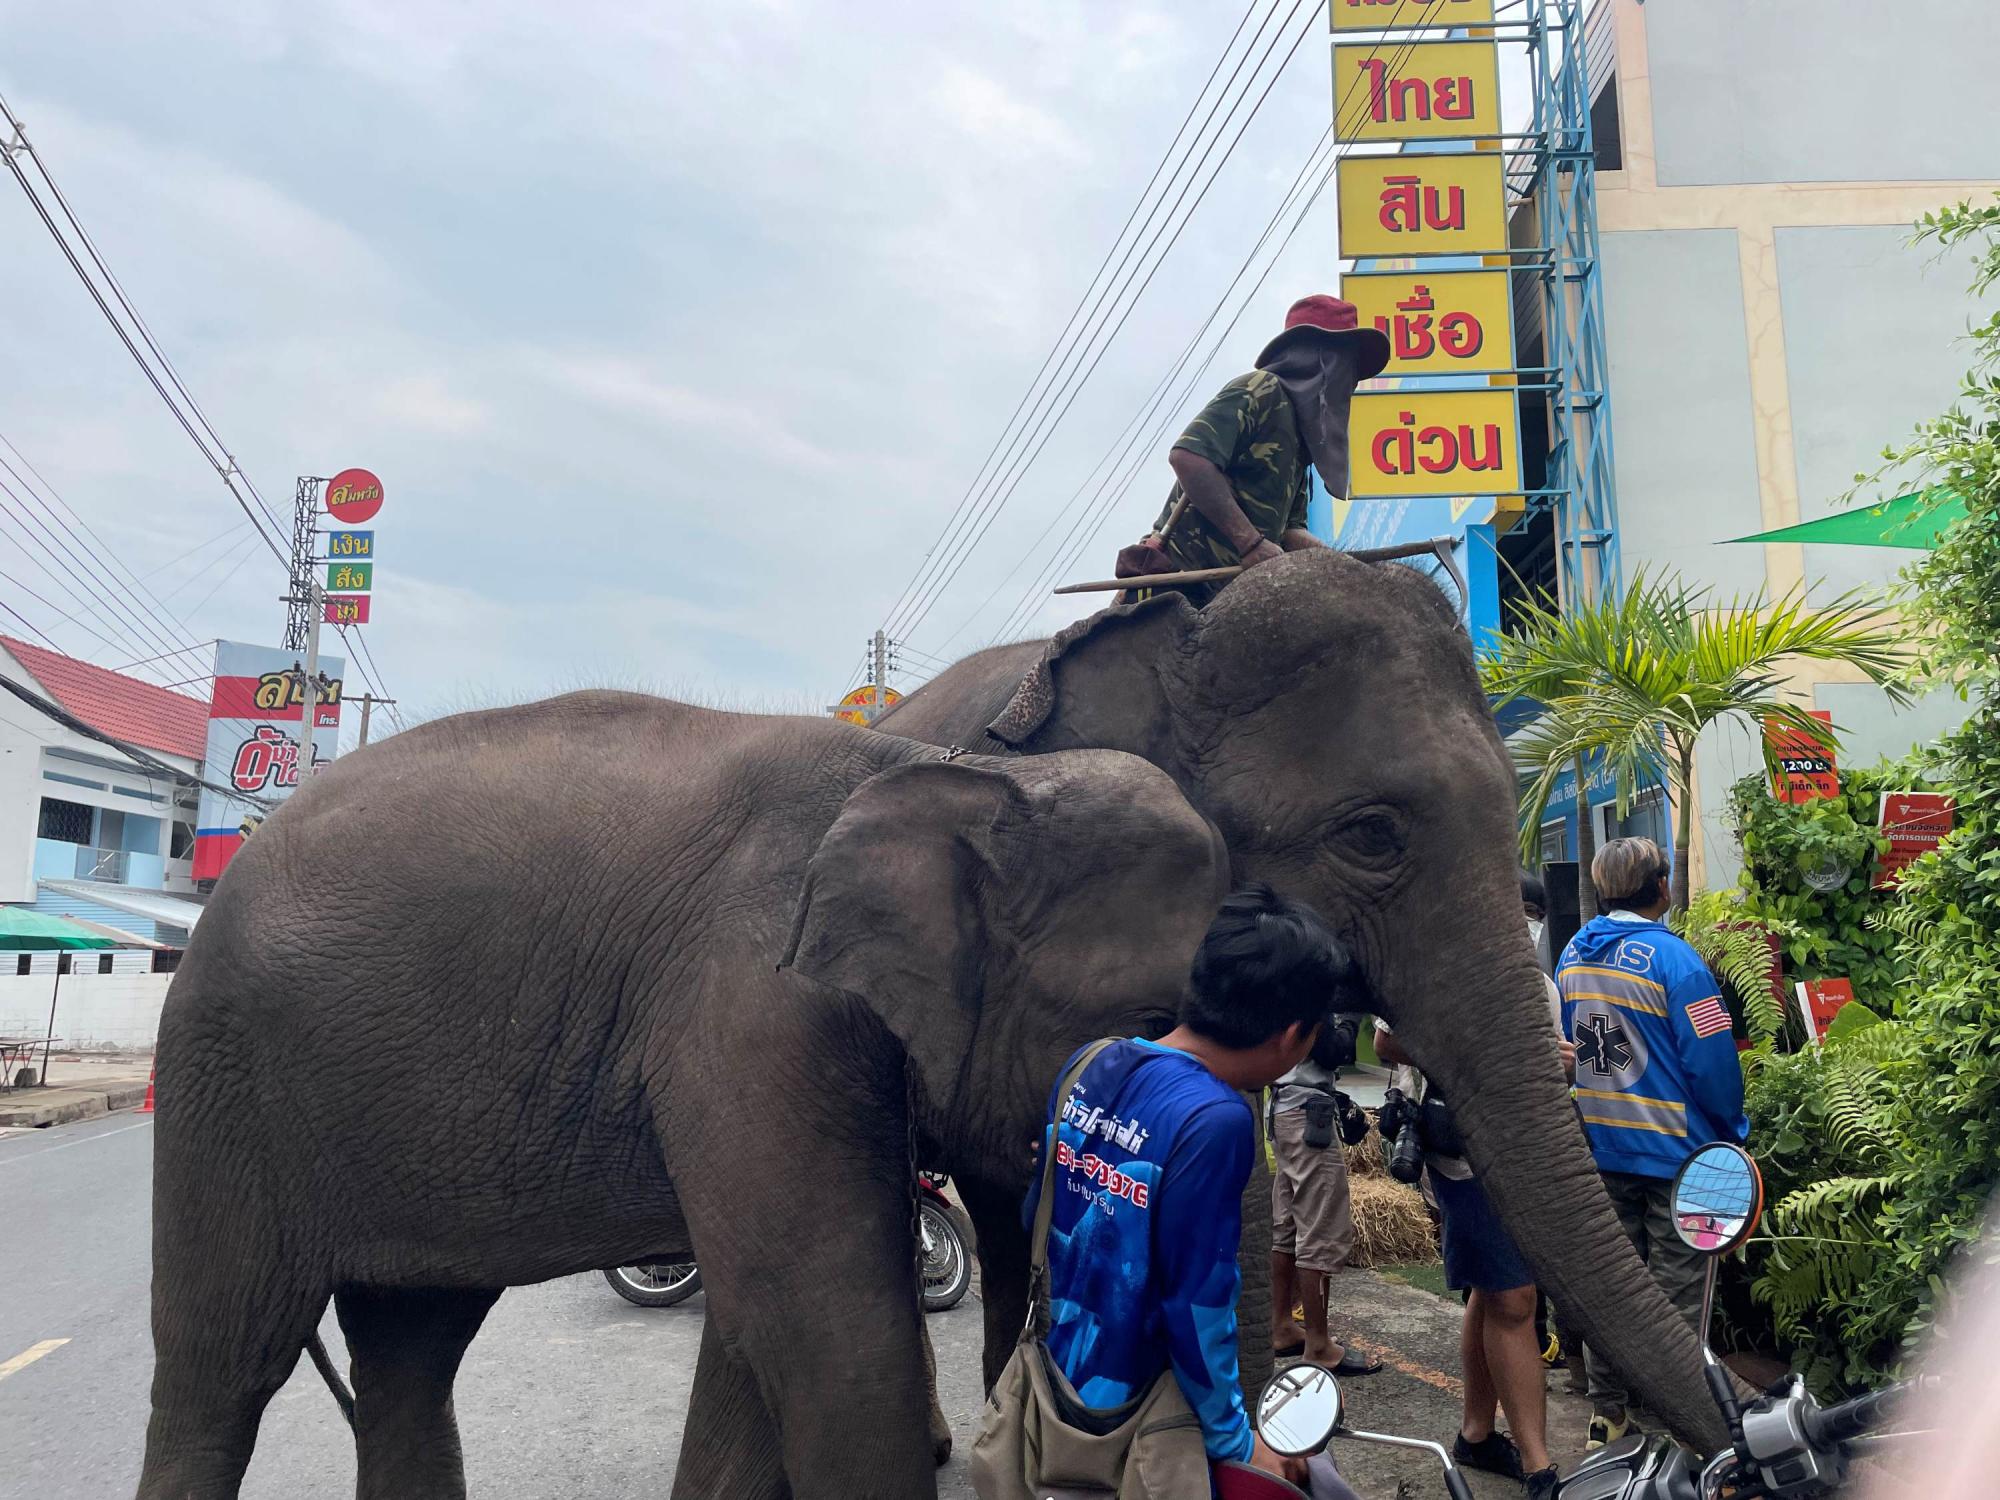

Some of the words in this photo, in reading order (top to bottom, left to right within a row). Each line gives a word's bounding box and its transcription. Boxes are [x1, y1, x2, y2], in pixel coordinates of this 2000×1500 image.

[1357, 58, 1475, 123] ไทย
[1379, 175, 1465, 232] สิน
[1371, 411, 1503, 475] ด่วน
[332, 533, 369, 555] เงิน
[336, 565, 365, 589] สั่ง
[1887, 832, 1939, 842] จัดการตนเอ
